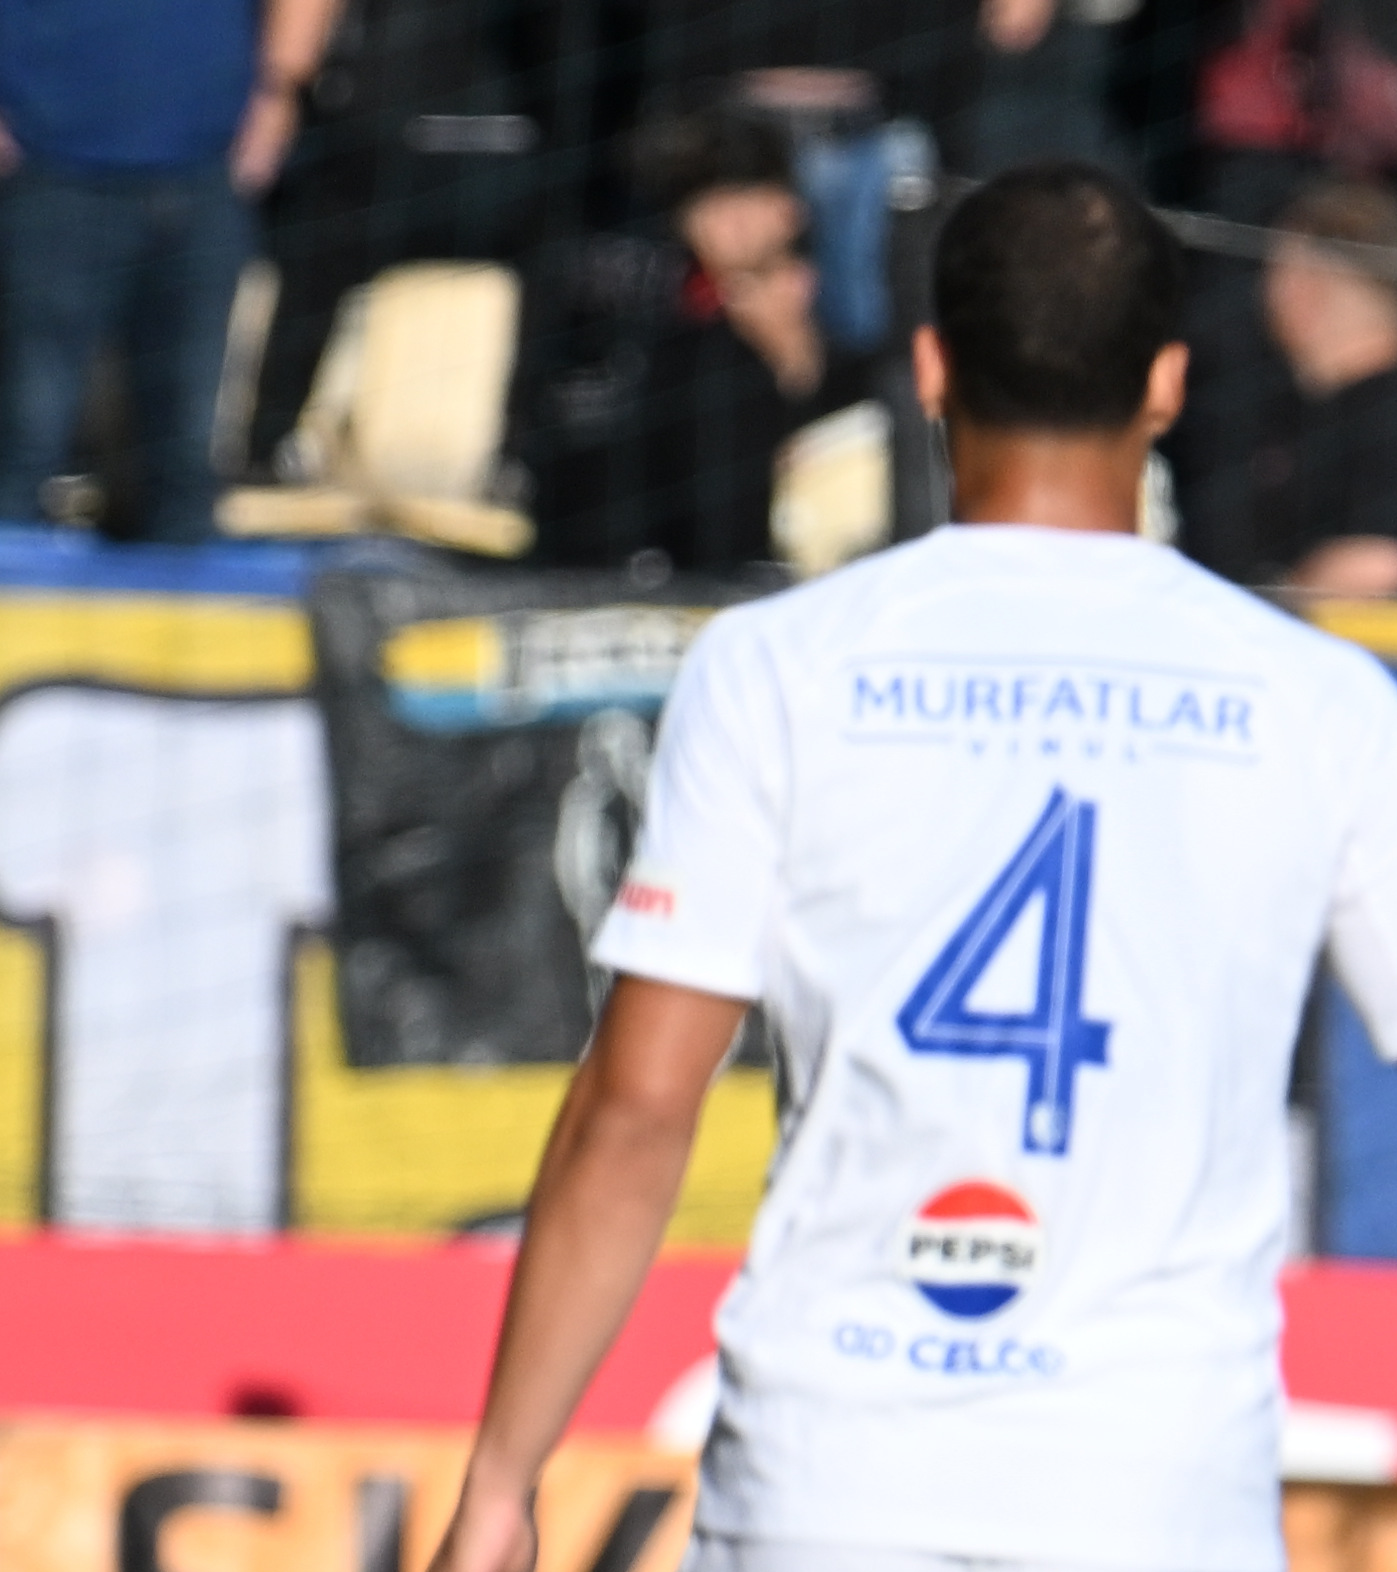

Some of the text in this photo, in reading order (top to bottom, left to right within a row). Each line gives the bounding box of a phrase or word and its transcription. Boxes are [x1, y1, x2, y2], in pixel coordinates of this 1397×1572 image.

[852, 674, 1254, 743] MURFATLAR
[896, 782, 1113, 1157] 4
[908, 1235, 1036, 1272] PEPSI
